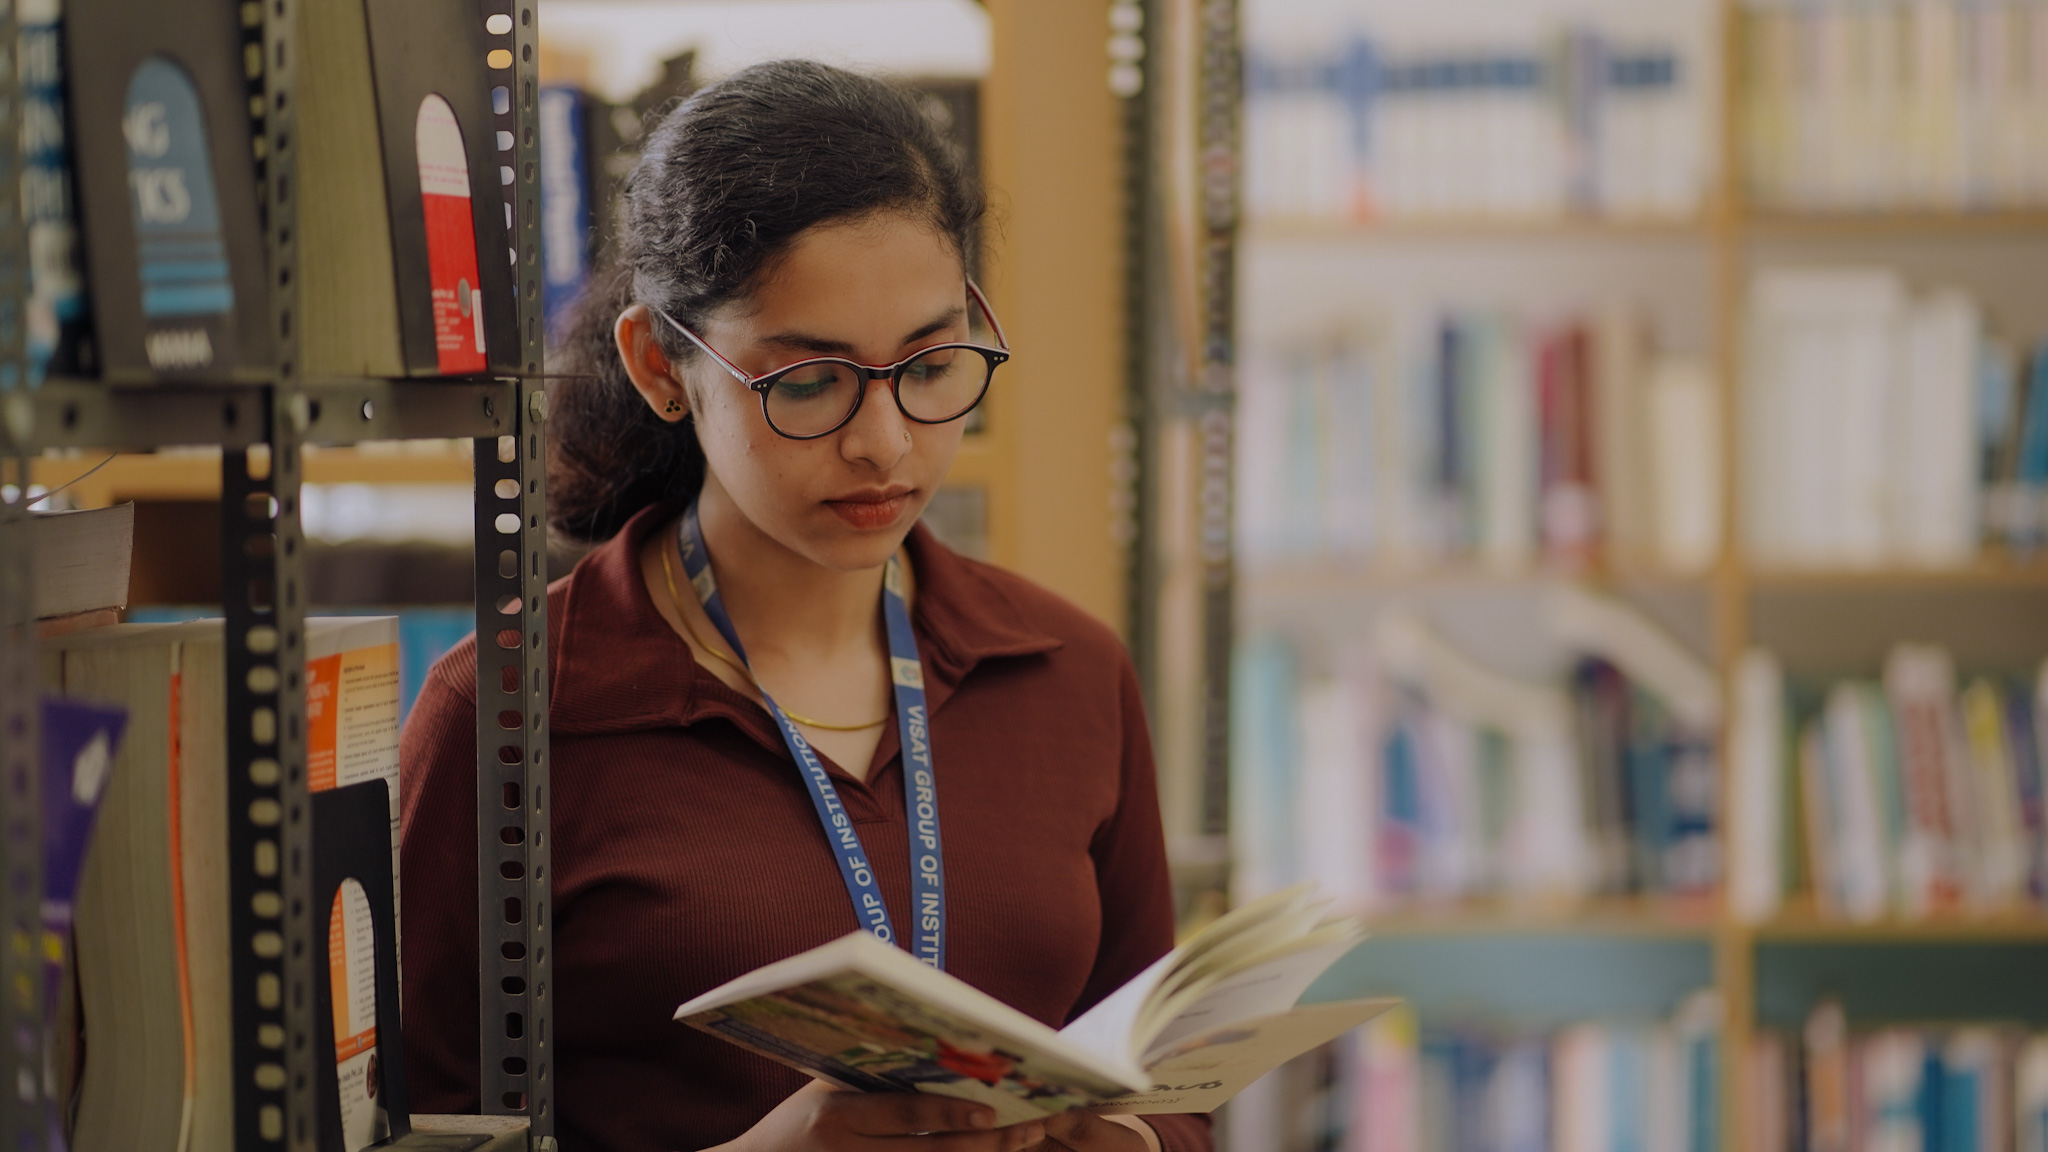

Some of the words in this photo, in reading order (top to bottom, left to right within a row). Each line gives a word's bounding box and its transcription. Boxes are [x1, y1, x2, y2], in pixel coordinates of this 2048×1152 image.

[907, 705, 929, 767] VISAT
[915, 771, 936, 850] GROUP
[848, 857, 872, 887] OF
[920, 855, 938, 886] OF
[862, 893, 891, 943] OUP
